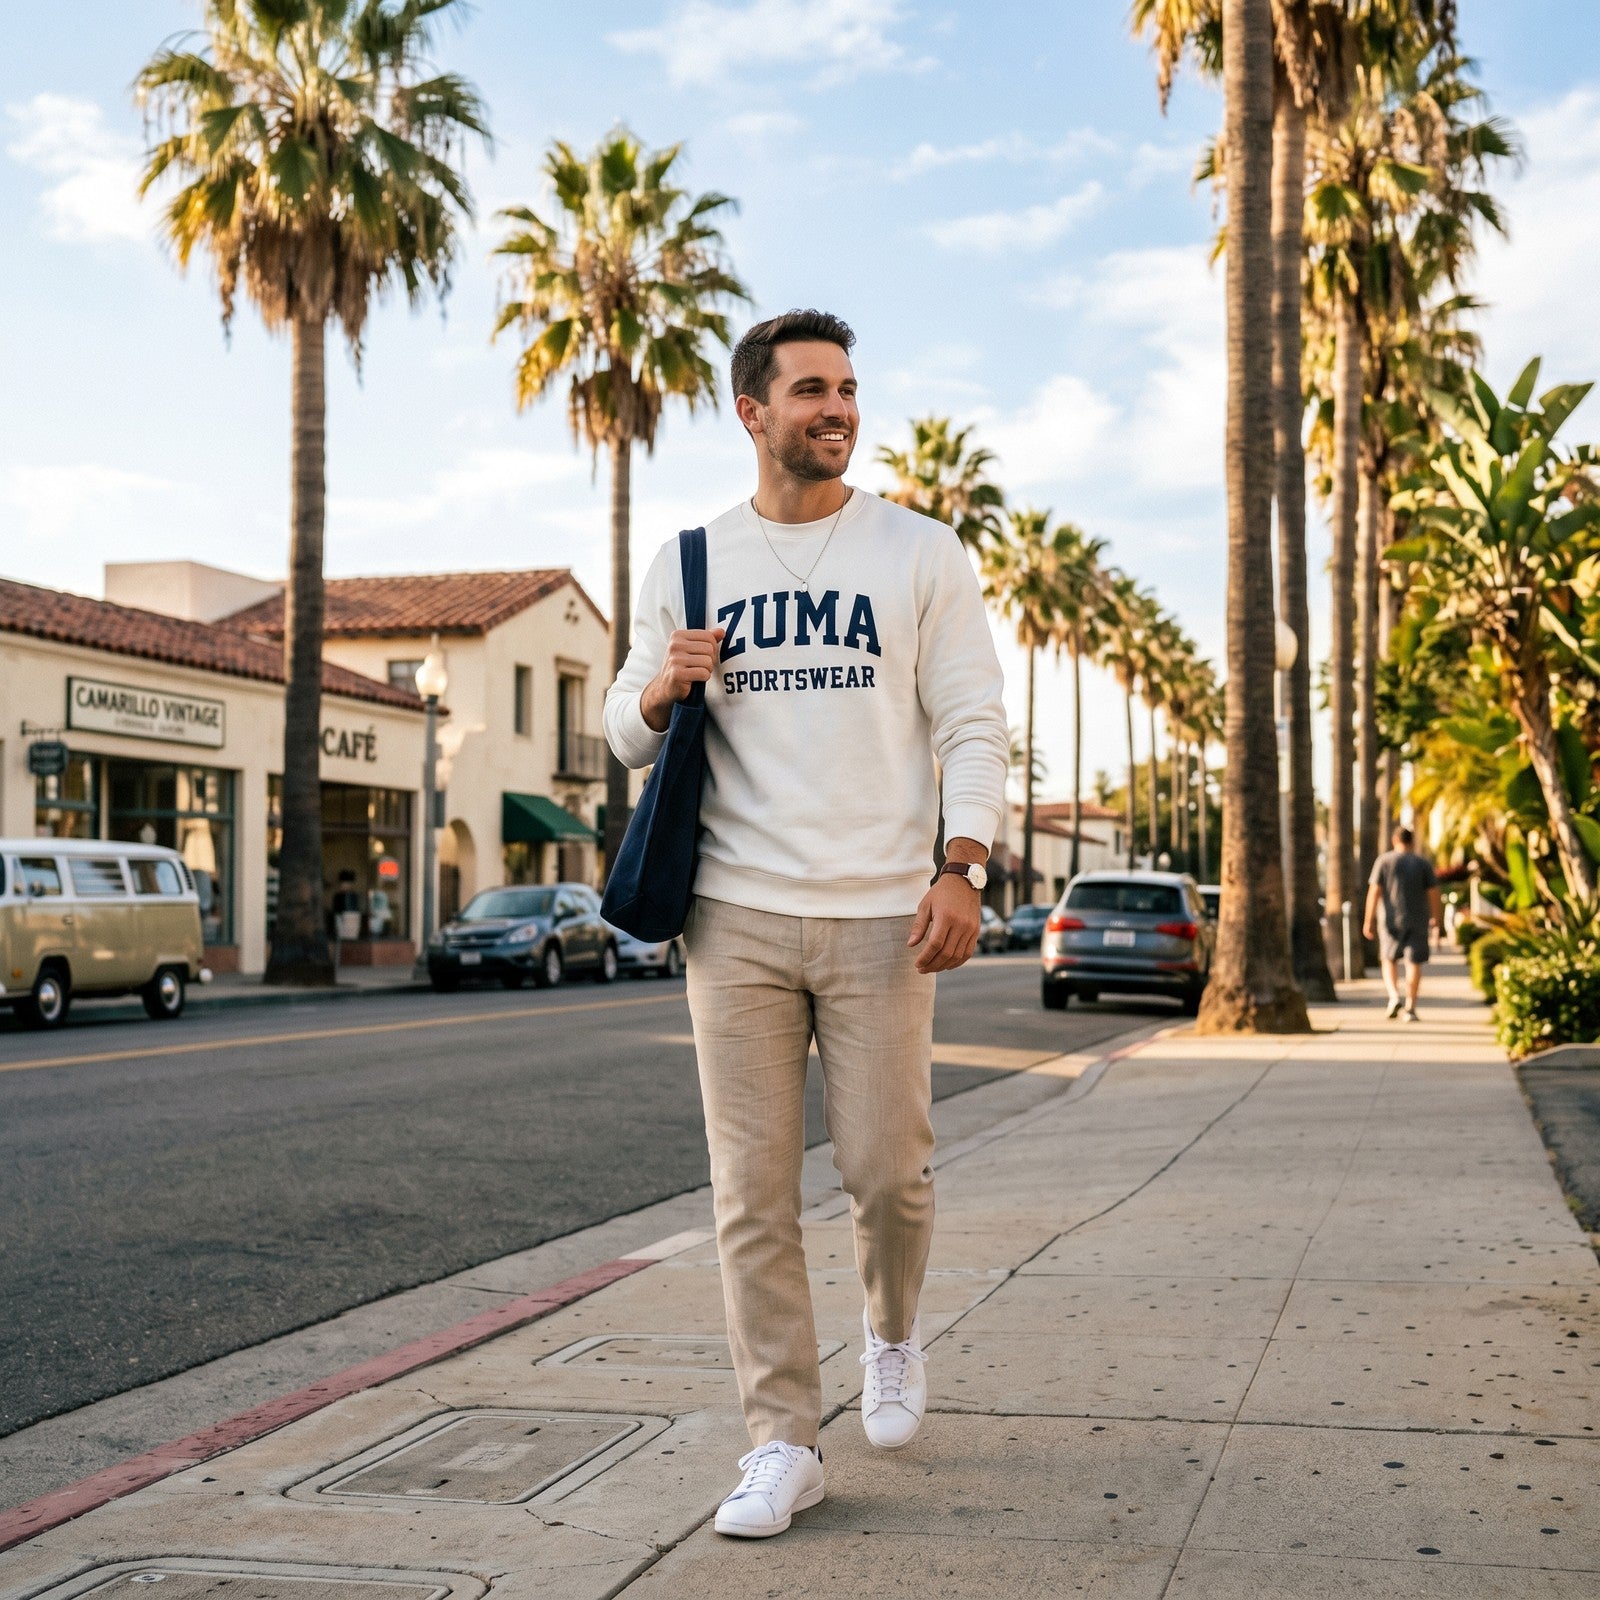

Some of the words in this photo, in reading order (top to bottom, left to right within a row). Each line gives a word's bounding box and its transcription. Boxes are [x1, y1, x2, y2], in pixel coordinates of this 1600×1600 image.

[717, 589, 882, 664] ZUMA
[723, 665, 876, 694] SPORTSWEAR
[76, 687, 159, 718] CAMARILLO
[163, 700, 219, 728] VINTAGE
[321, 723, 376, 762] CAFÉ
